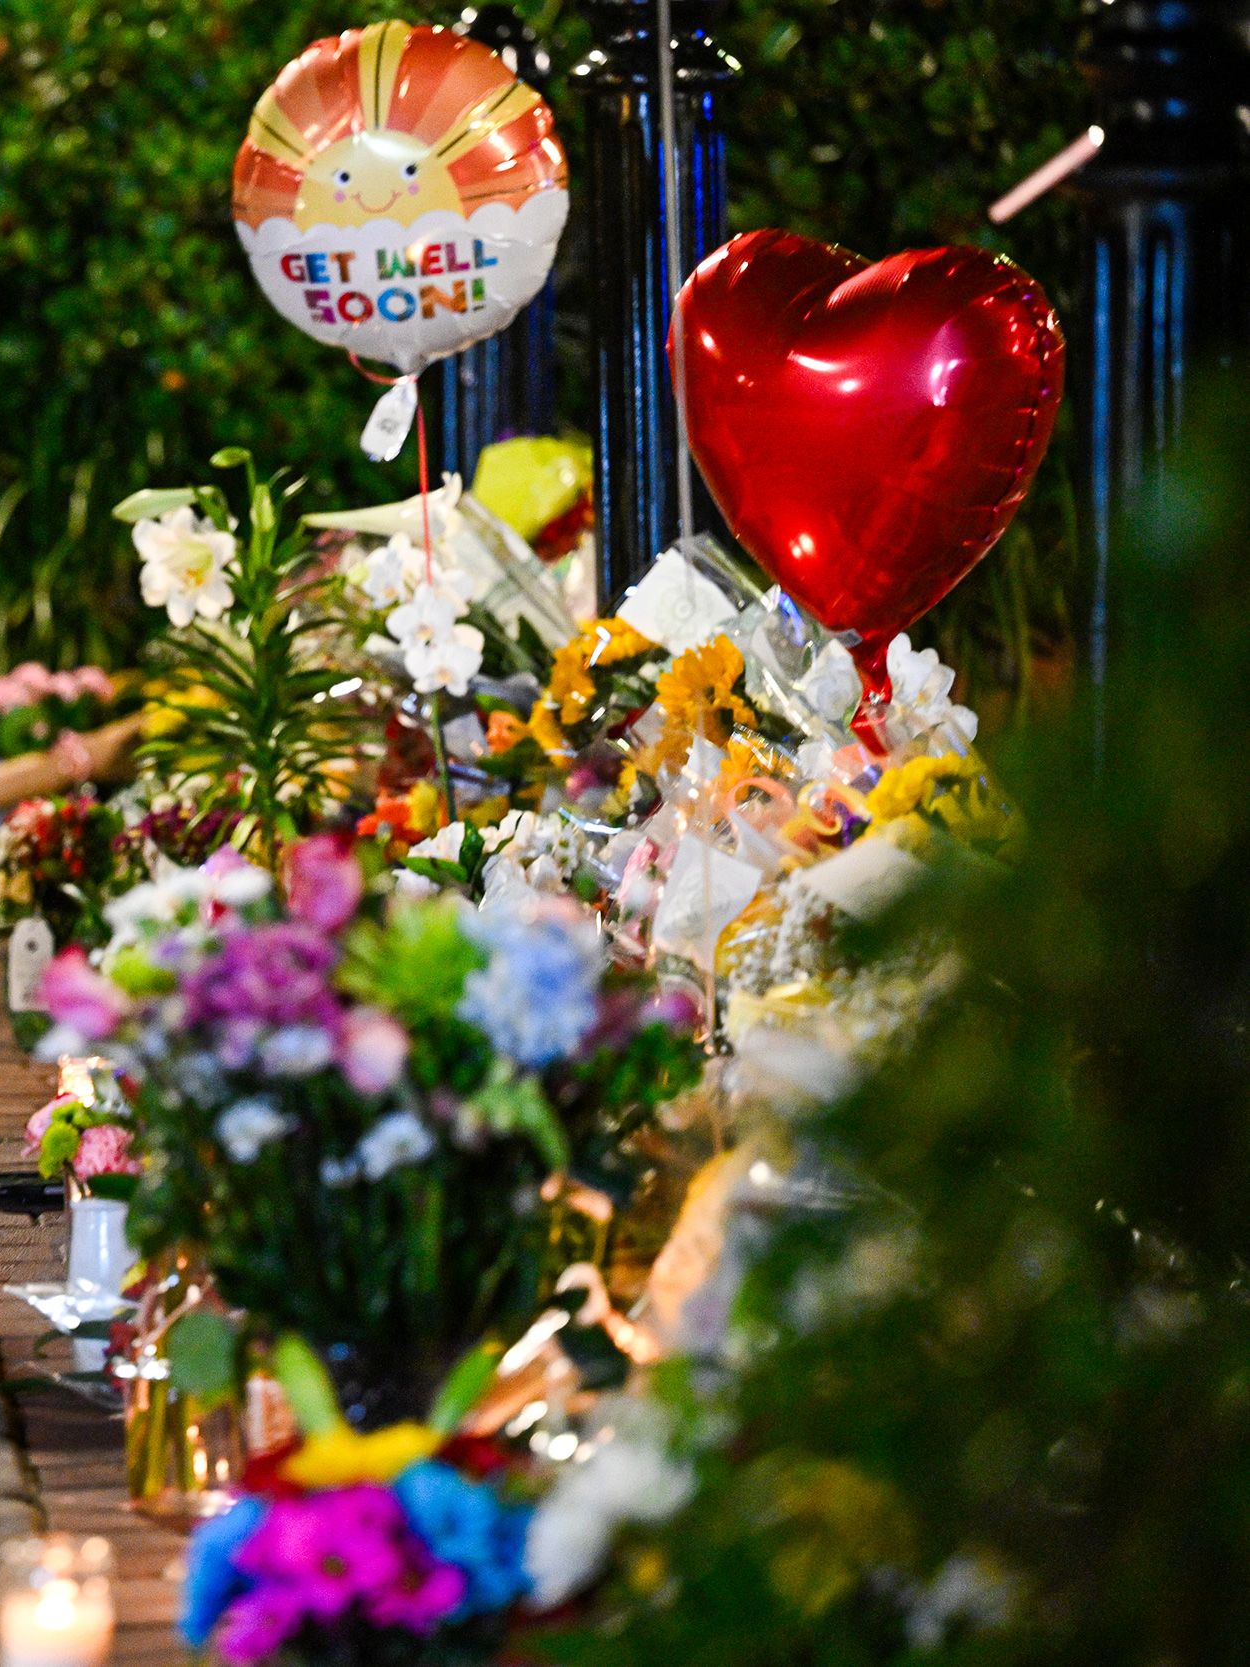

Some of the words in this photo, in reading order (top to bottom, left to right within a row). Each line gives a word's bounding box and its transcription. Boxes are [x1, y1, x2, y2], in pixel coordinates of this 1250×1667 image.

[281, 252, 355, 284] GET
[376, 239, 498, 280] WELL
[304, 278, 485, 324] SOON!
